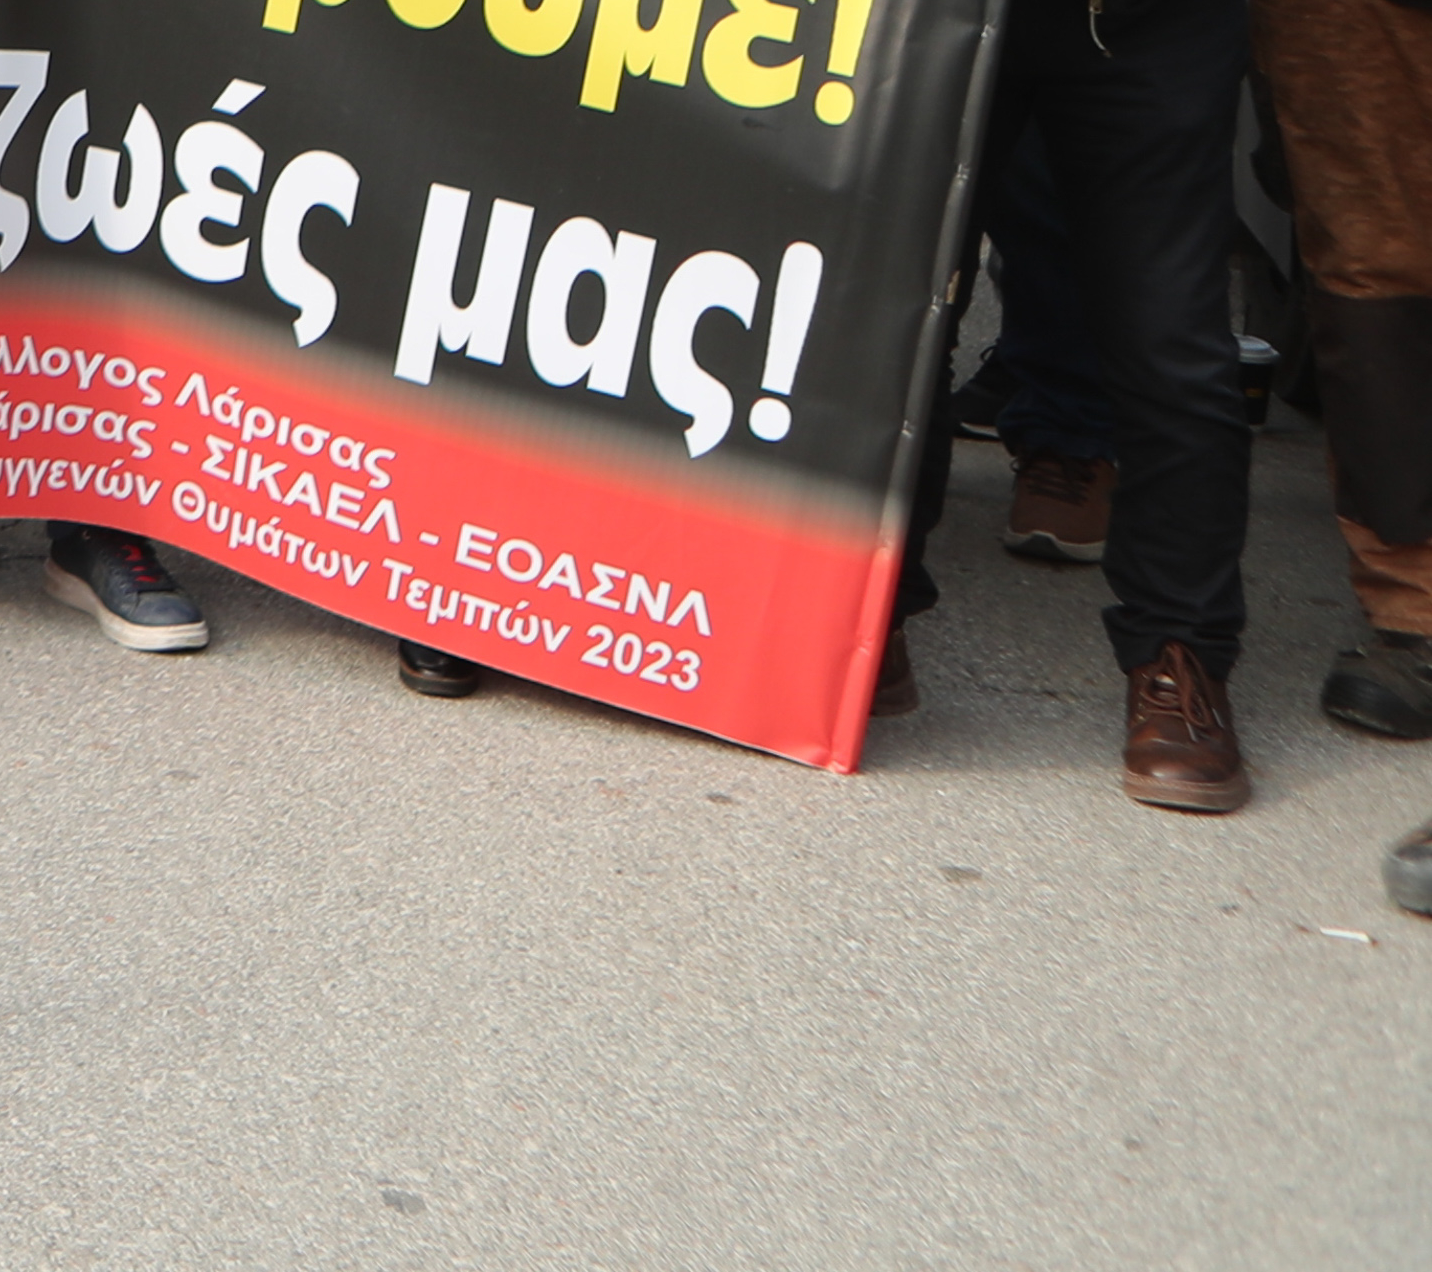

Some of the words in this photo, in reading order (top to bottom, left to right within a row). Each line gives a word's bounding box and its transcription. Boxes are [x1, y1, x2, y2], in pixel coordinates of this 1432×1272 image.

[394, 183, 825, 460] μας!
[175, 372, 397, 489] Λάρισας
[170, 479, 370, 589] Θυμάτων
[380, 557, 571, 653] Τεμπών
[582, 624, 703, 694] 2023
[201, 434, 402, 545] ΣΙΚΑΕΛ
[453, 522, 714, 638] ΕΟΑΣΝΛ
